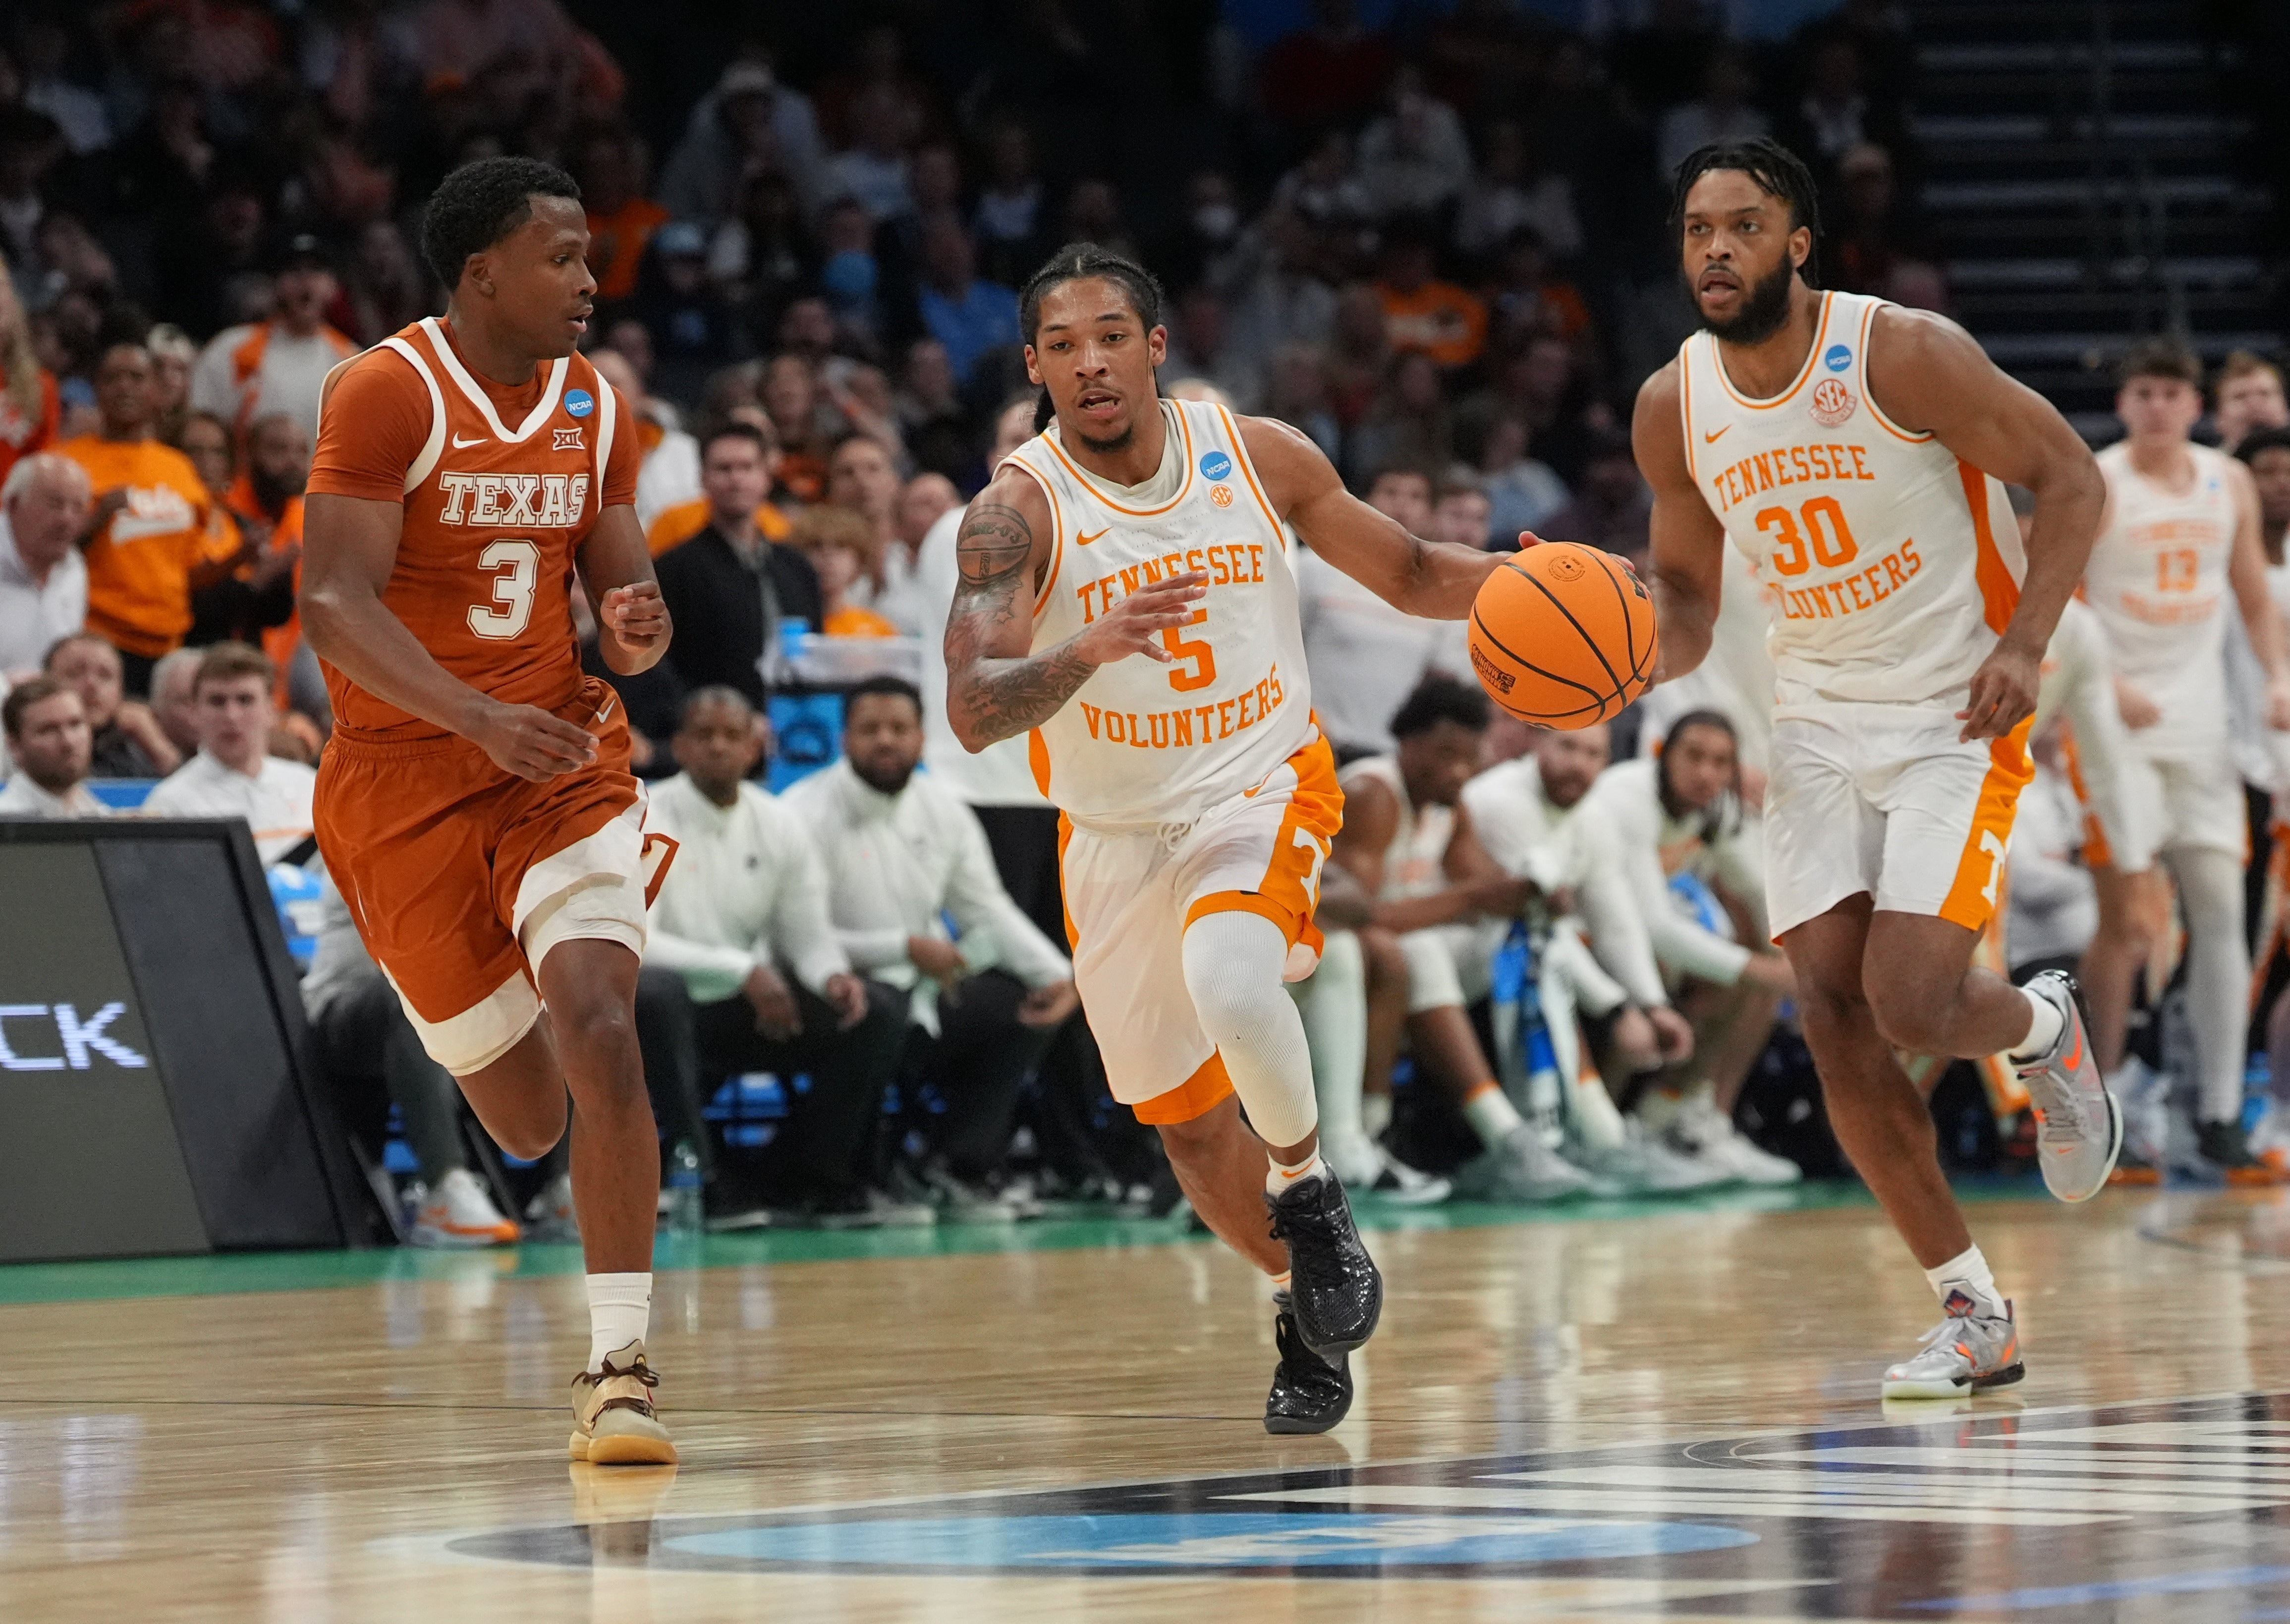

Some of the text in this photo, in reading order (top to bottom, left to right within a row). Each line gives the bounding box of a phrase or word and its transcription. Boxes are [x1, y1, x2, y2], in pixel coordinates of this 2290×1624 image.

[568, 400, 592, 411] NCAA
[1816, 381, 1846, 413] SEC
[553, 428, 584, 449] XII
[1206, 460, 1230, 476] NCAA
[1212, 485, 1232, 506] SEC
[1713, 444, 1875, 511] TENNESSEE
[439, 471, 590, 528] TEXAS
[1755, 495, 1858, 576] 30
[467, 539, 540, 640] 3
[1162, 607, 1217, 693] 5
[1080, 661, 1284, 749] VOLUNTEERS
